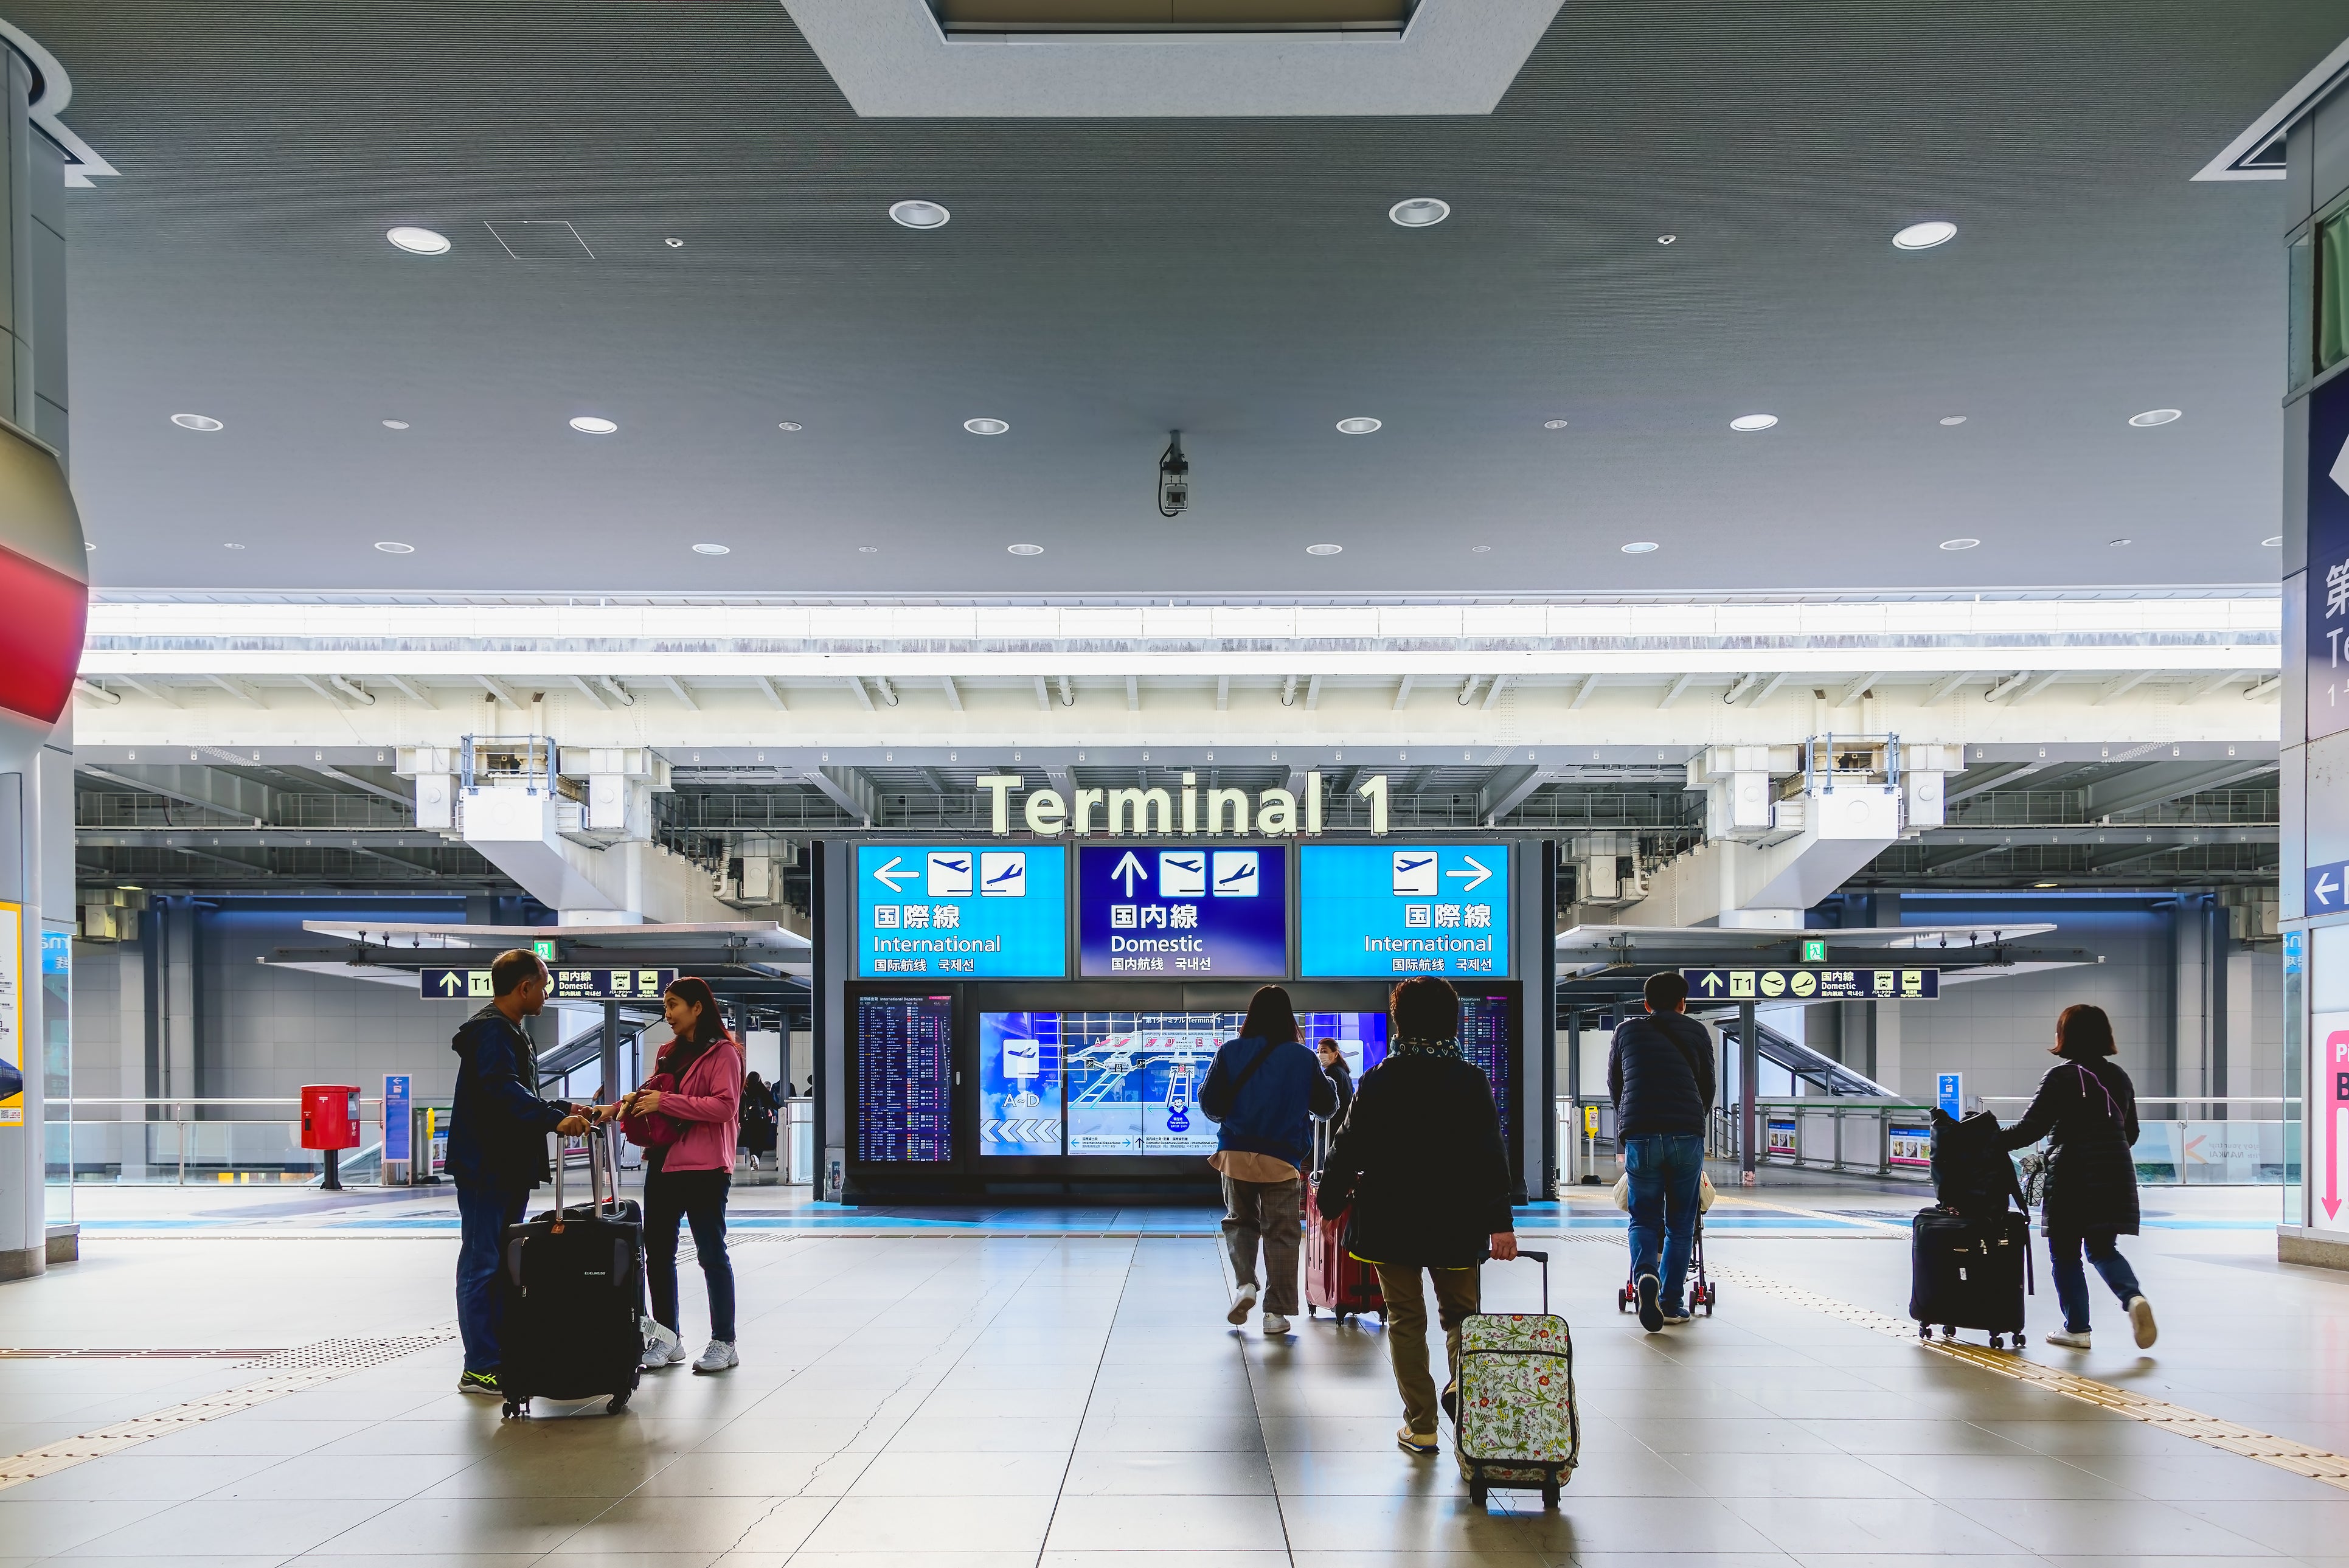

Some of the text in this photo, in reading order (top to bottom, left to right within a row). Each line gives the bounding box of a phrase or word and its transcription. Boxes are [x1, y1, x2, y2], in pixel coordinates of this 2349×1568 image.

[976, 771, 1390, 838] Terminal 1
[873, 904, 960, 929] 国際線
[1111, 904, 1198, 929] 国内線
[1404, 904, 1491, 929] 国際線
[874, 935, 1001, 952] International
[1111, 934, 1203, 952] Domestic
[1364, 934, 1492, 952] International
[875, 958, 974, 973] 国际航线 국제선
[1111, 957, 1211, 971] 国内航线 국내선
[1392, 958, 1492, 973] 国际航线 국제선
[559, 971, 592, 982] 国内線
[1821, 971, 1855, 982] 国内線
[471, 978, 490, 990] T1
[1733, 979, 1751, 991] T1
[1821, 982, 1856, 990] Domestic
[1147, 1037, 1153, 1046] C
[1167, 1037, 1173, 1046] D
[1197, 1037, 1202, 1046] E
